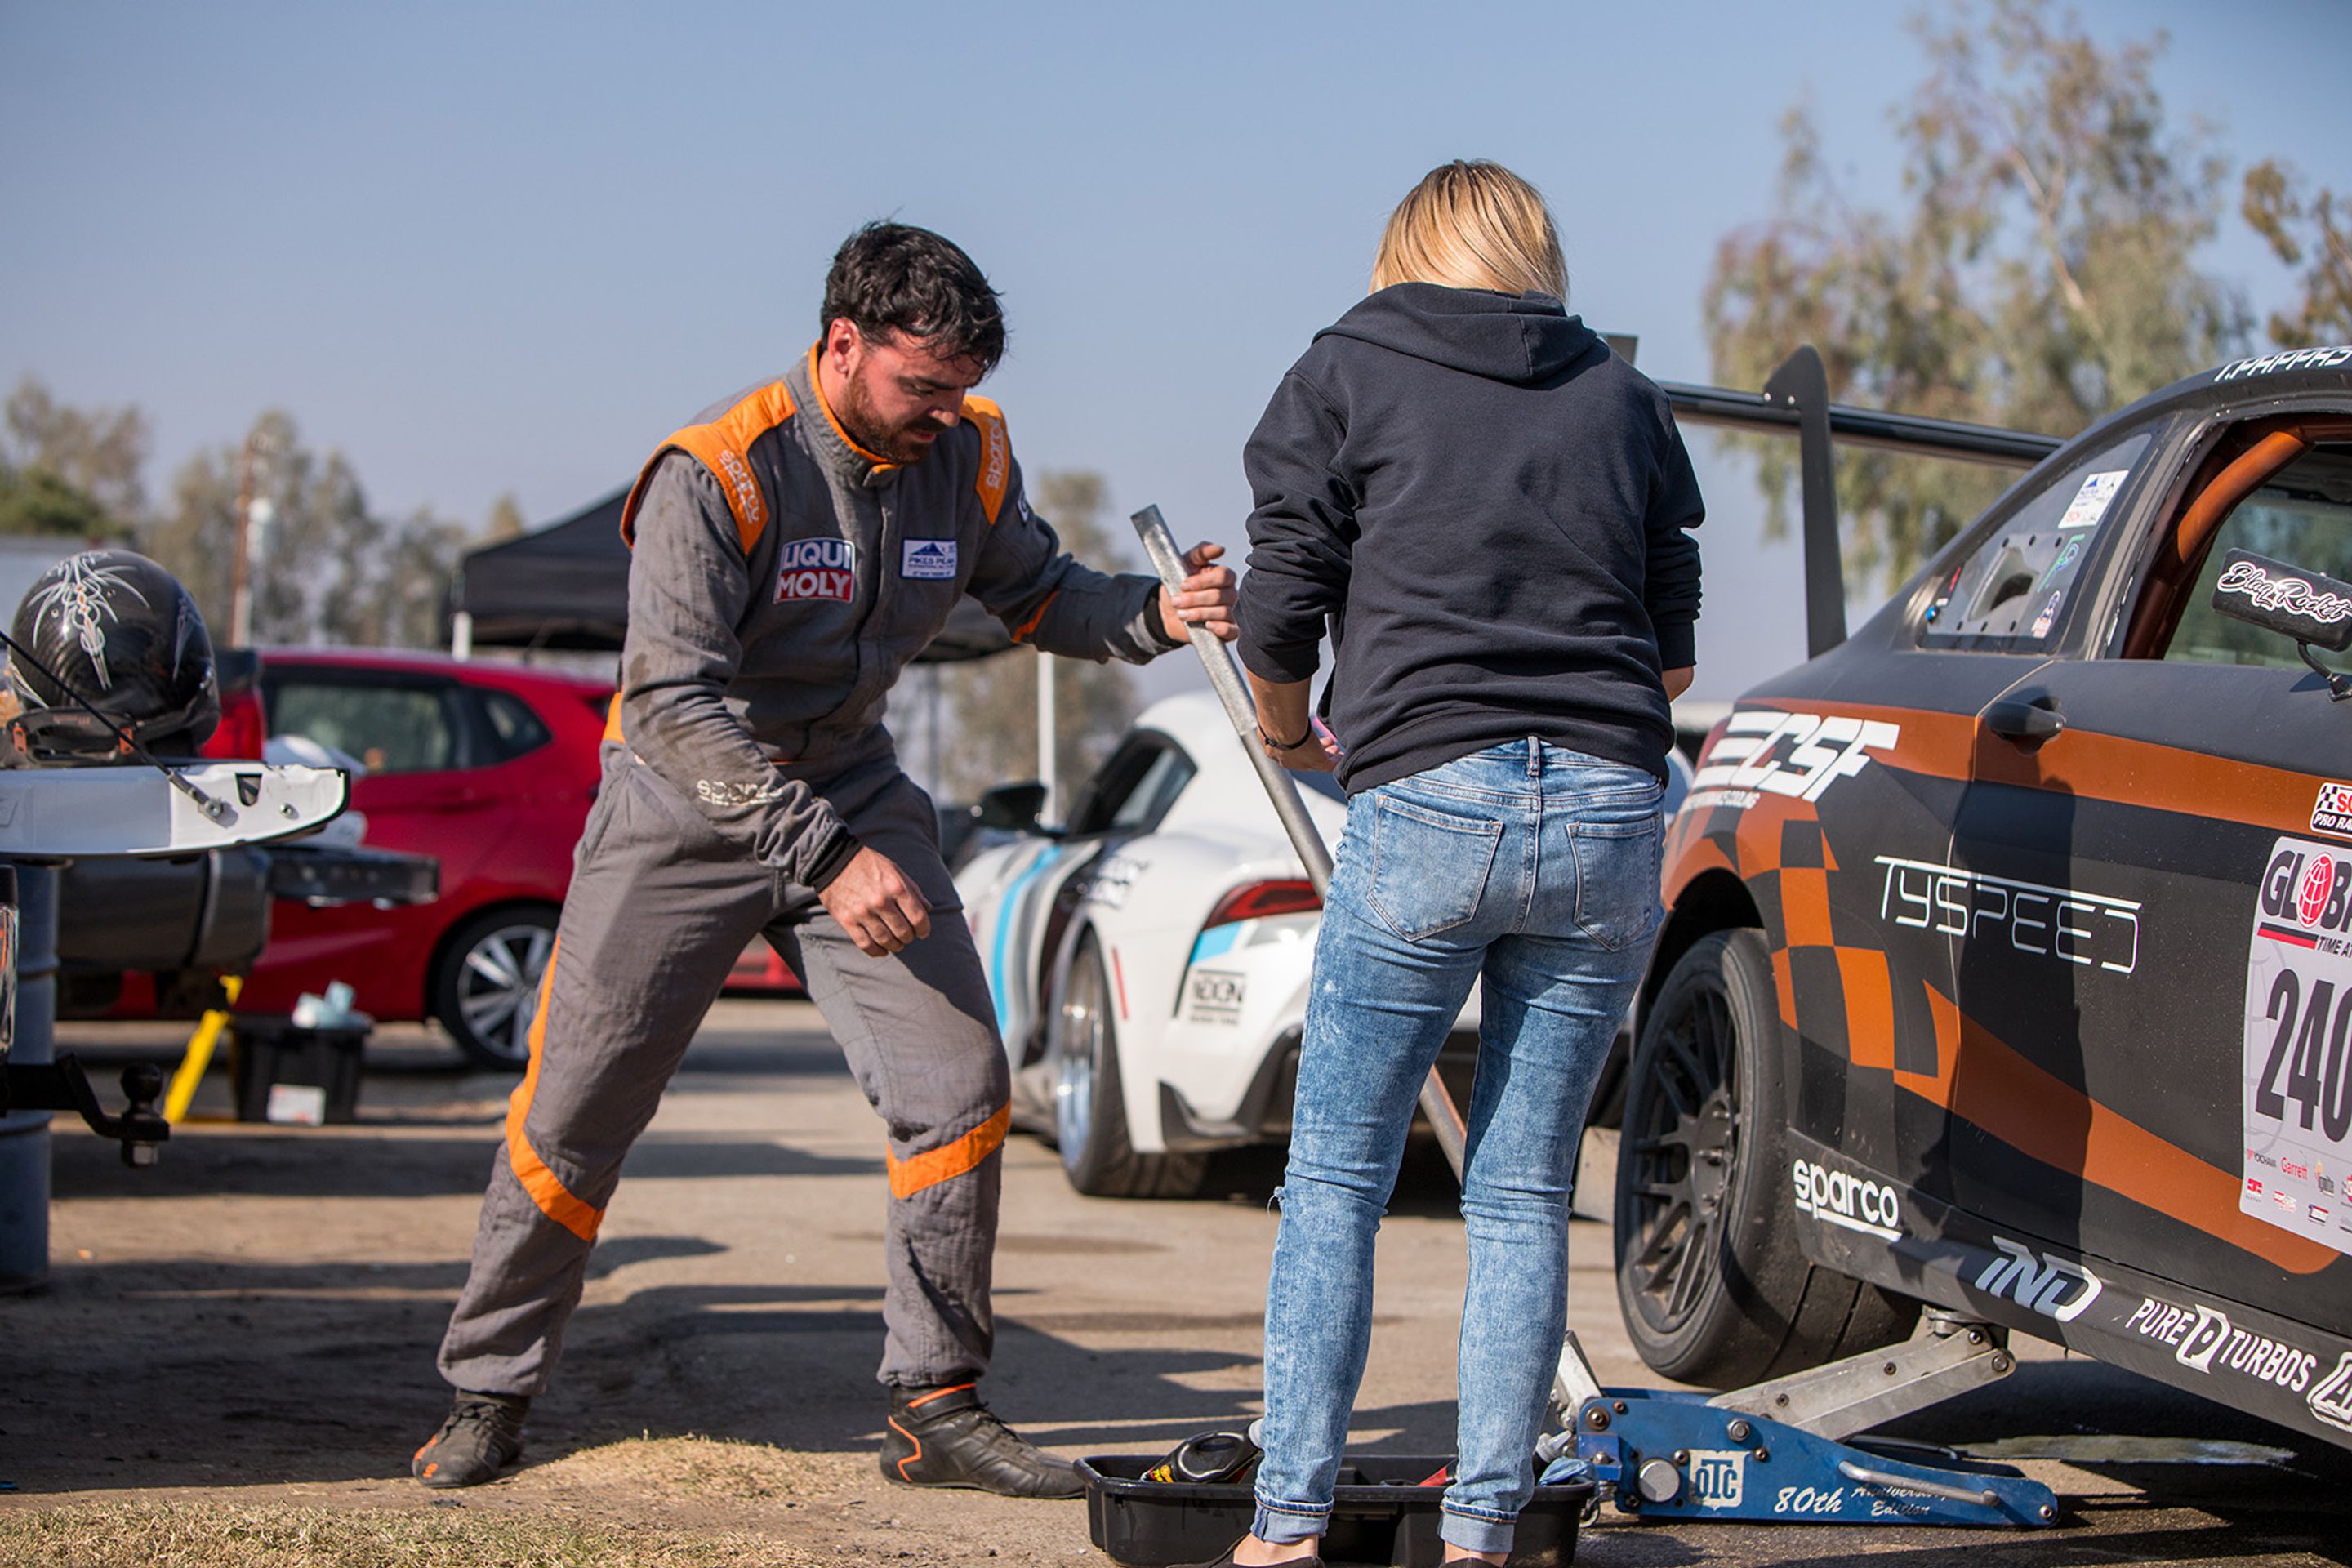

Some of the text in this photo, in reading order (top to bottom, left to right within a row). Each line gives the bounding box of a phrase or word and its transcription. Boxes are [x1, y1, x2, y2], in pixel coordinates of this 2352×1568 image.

[782, 541, 851, 569] LIQUI
[776, 571, 851, 600] MOLY
[2218, 561, 2352, 623] Blaq Rocket
[2313, 813, 2337, 828] PRO
[2317, 935, 2343, 955] TIME
[2255, 968, 2352, 1143] 240
[1793, 1158, 1900, 1227] sparco
[2125, 1297, 2197, 1347] PURE
[2219, 1328, 2318, 1392] TURBOS
[1695, 1459, 1738, 1499] OTC
[1773, 1486, 1845, 1514] 80th
[1870, 1499, 1931, 1517] Edition
